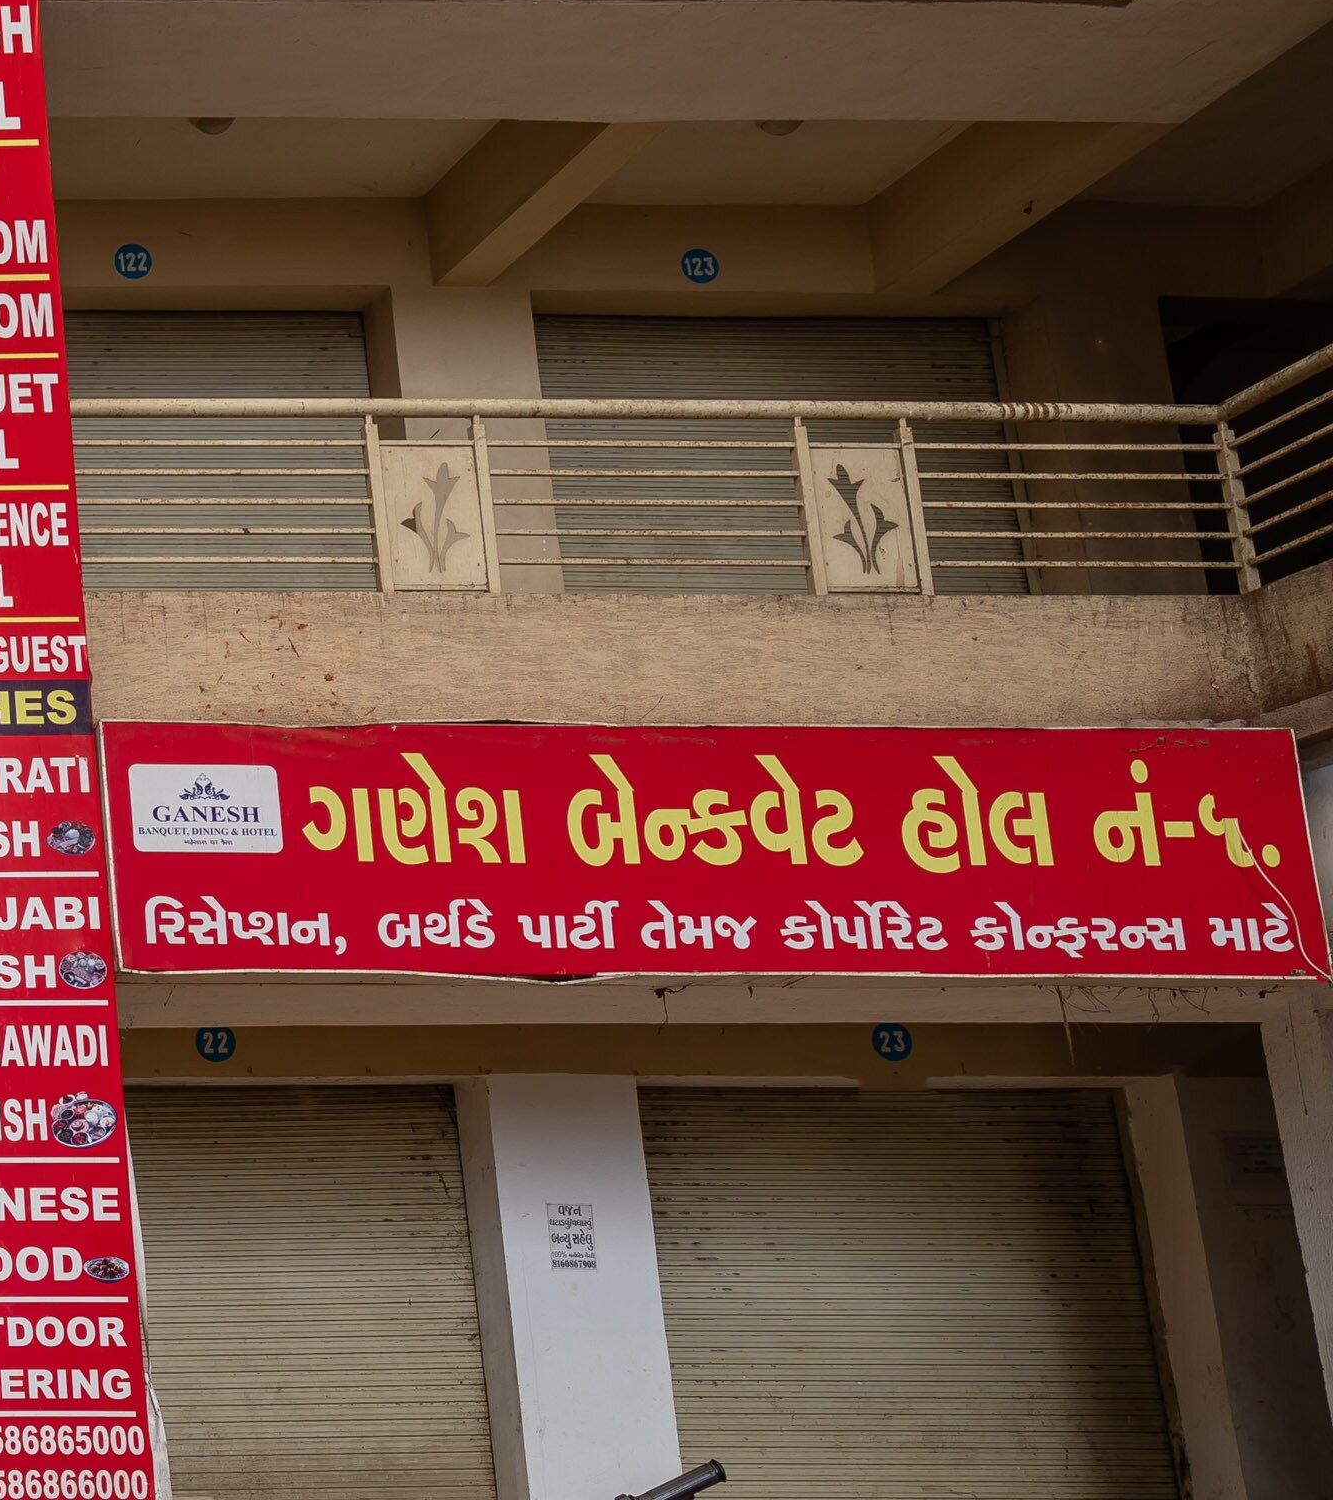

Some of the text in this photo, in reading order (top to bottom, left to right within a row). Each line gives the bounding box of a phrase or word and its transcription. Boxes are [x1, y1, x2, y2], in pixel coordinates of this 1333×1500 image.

[118, 252, 148, 272] 122
[684, 257, 715, 276] 123
[151, 804, 261, 825] GANESH
[302, 752, 527, 865] ગણેશ
[566, 753, 865, 867] બેન્કવેટ
[901, 755, 1055, 874] હોલ
[138, 826, 278, 837] BANQUET, DINING & HOTEL
[144, 895, 348, 956] રિસેપ્શન,
[377, 898, 496, 950] બર્થડે
[517, 899, 620, 950] પાર્ટી
[640, 900, 758, 951] તેમજ
[970, 901, 1188, 959] કોન્ફરન્સ
[1208, 902, 1296, 953] માટે
[202, 1031, 229, 1054] 22
[879, 1030, 906, 1053] 23
